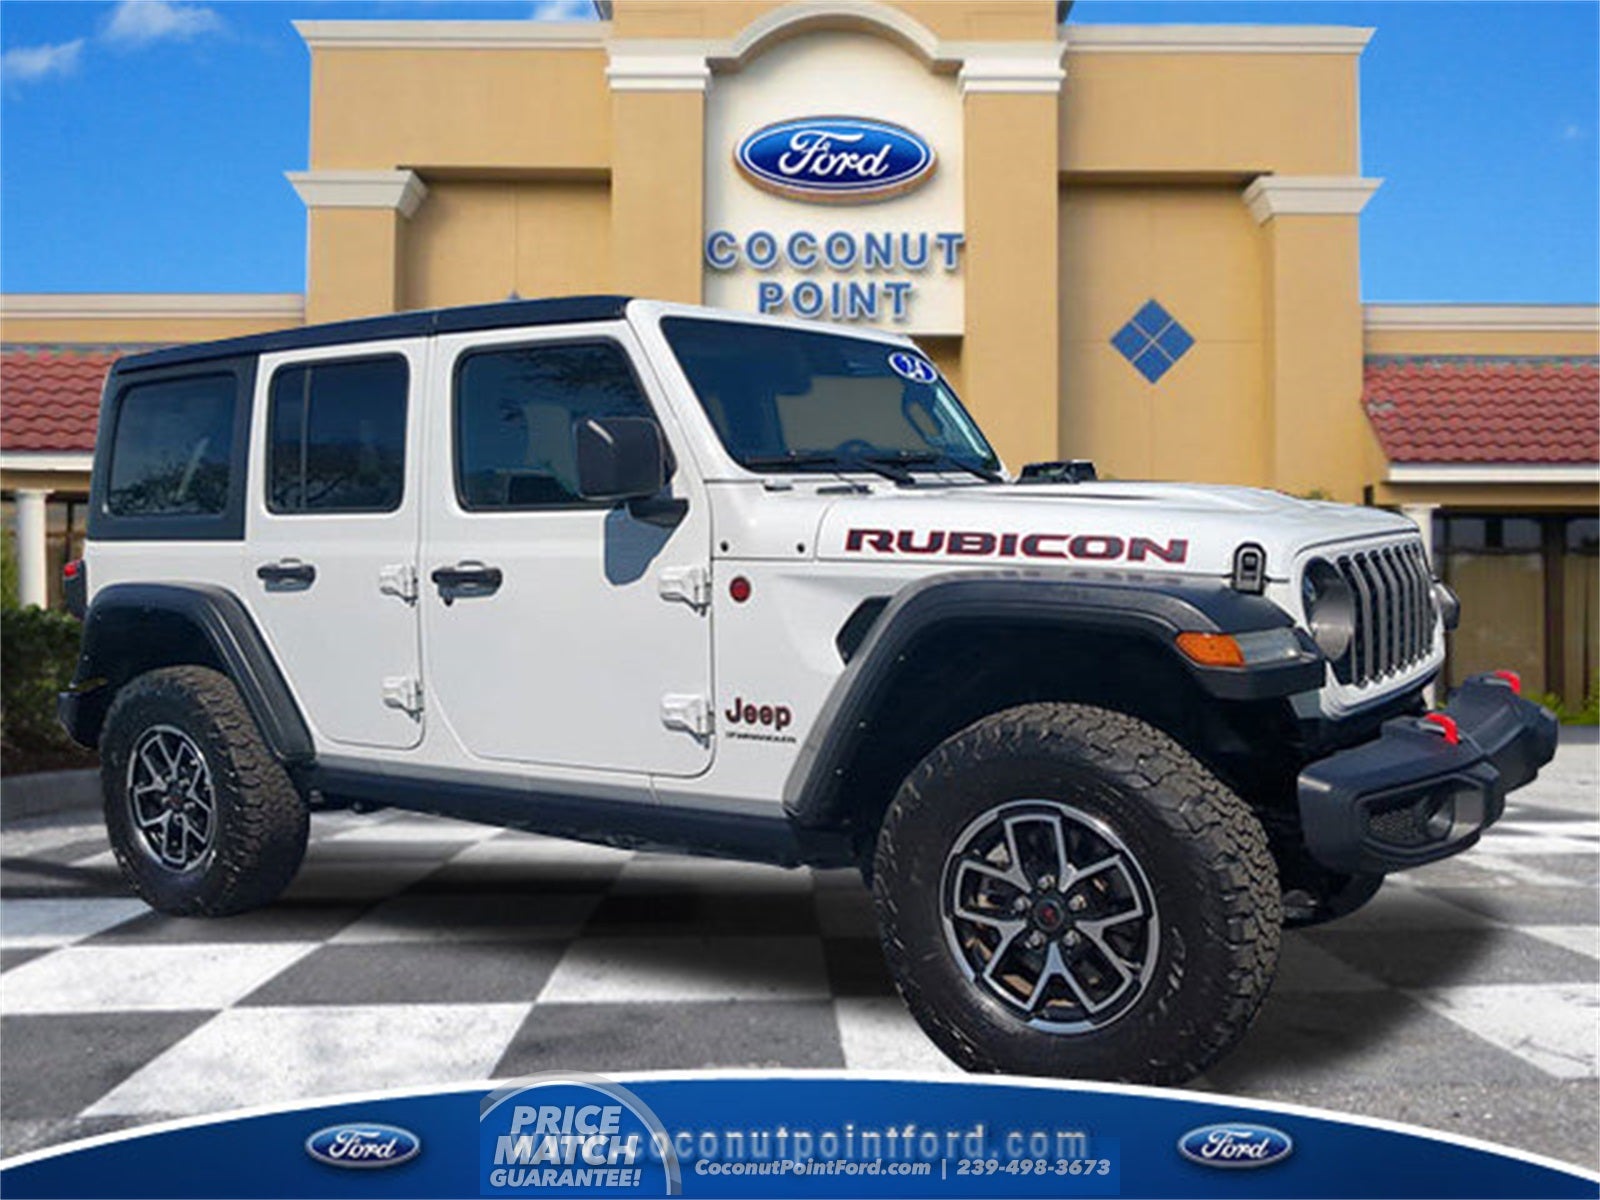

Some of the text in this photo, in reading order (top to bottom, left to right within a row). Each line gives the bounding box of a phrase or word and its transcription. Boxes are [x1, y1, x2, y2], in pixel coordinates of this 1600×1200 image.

[778, 129, 892, 176] Ford
[706, 231, 964, 268] COCONUT
[758, 281, 911, 317] POINT
[845, 528, 1188, 564] RUBICON
[725, 697, 791, 731] Jeep
